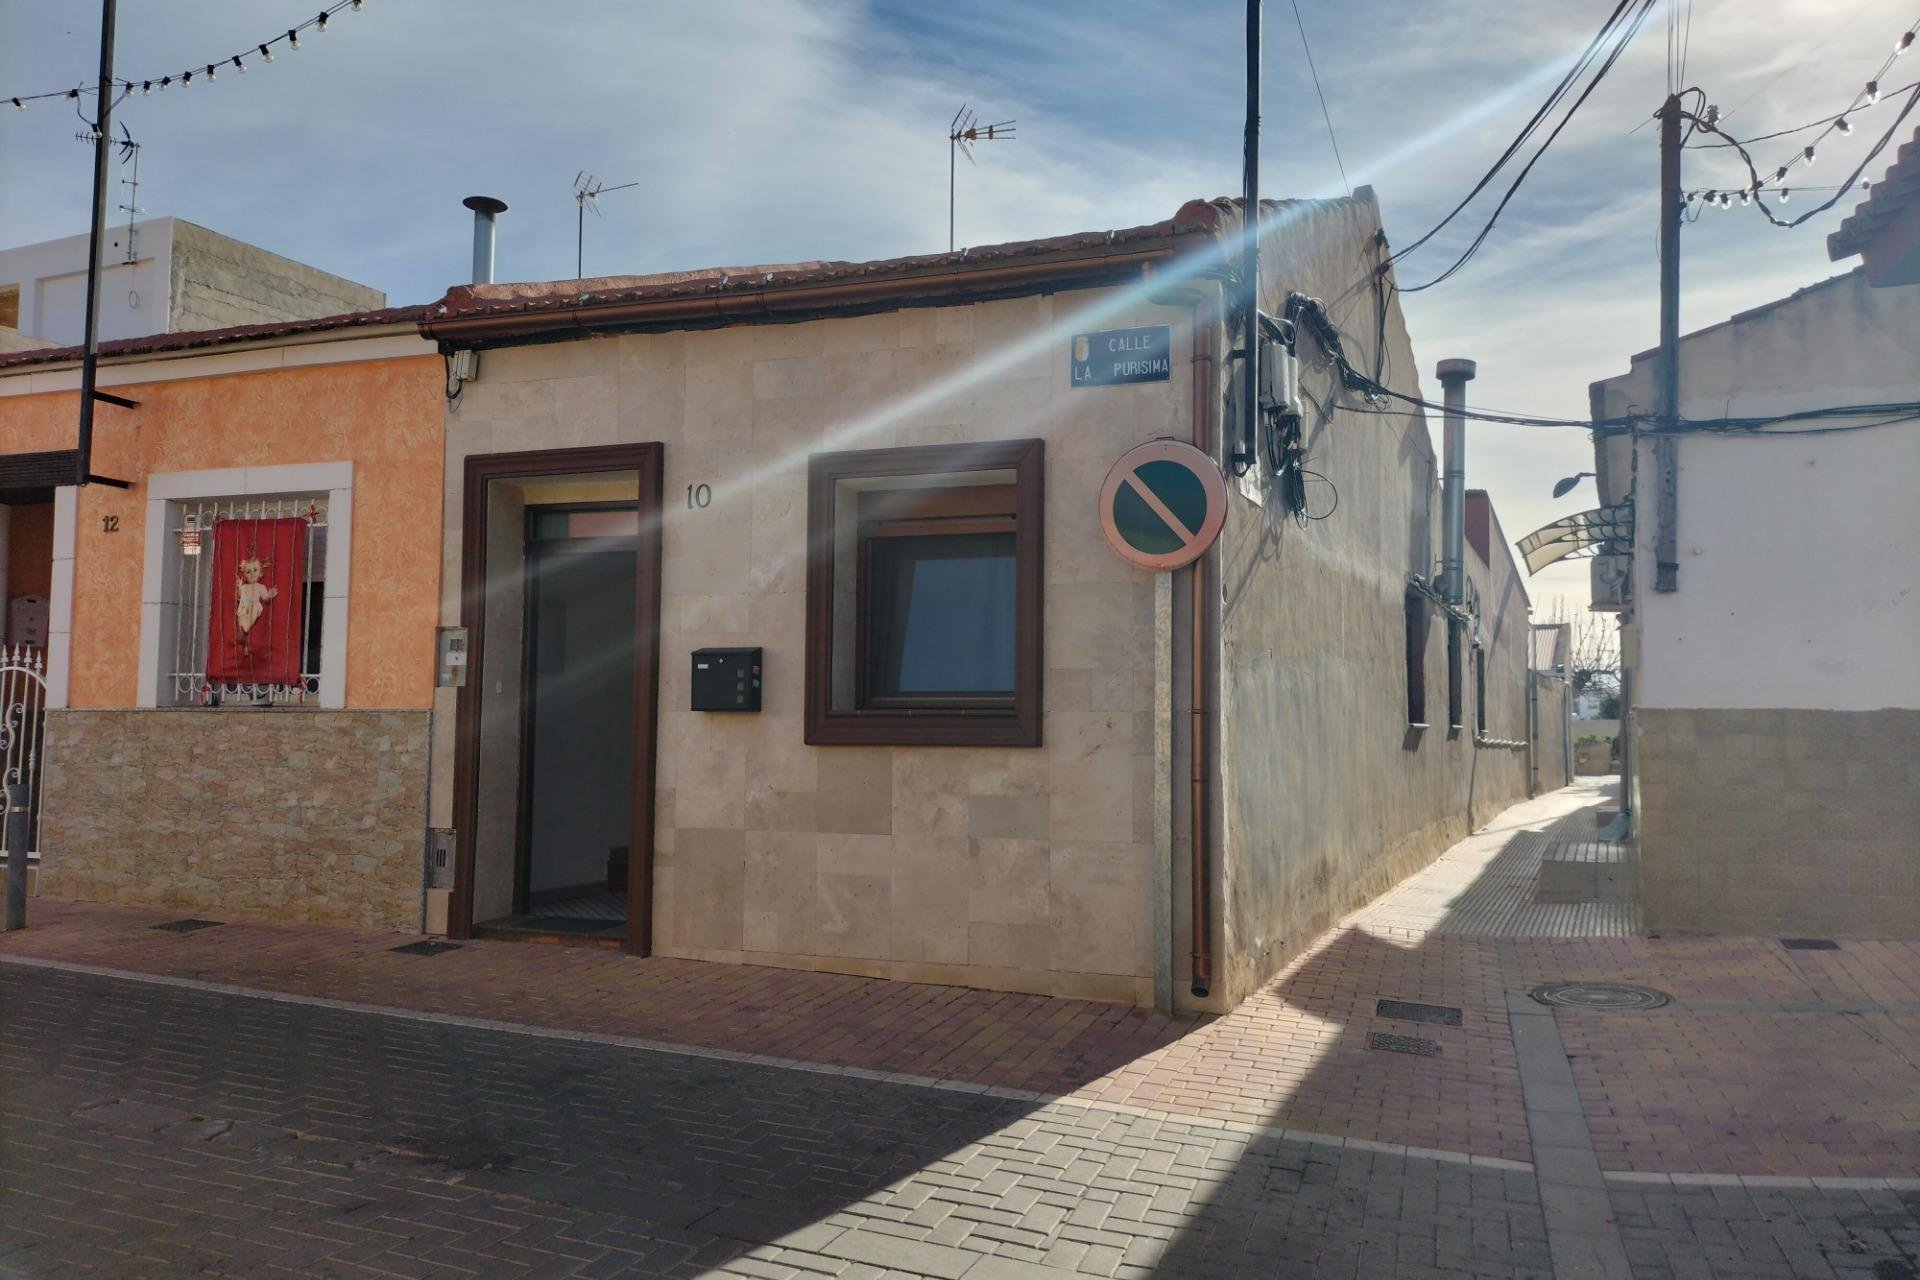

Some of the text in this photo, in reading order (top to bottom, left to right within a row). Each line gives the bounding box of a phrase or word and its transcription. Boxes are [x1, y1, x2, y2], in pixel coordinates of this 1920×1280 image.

[1108, 335, 1151, 352] CALLE
[1074, 359, 1169, 381] LA PURISIMA
[687, 484, 712, 509] 10
[102, 515, 120, 532] 12
